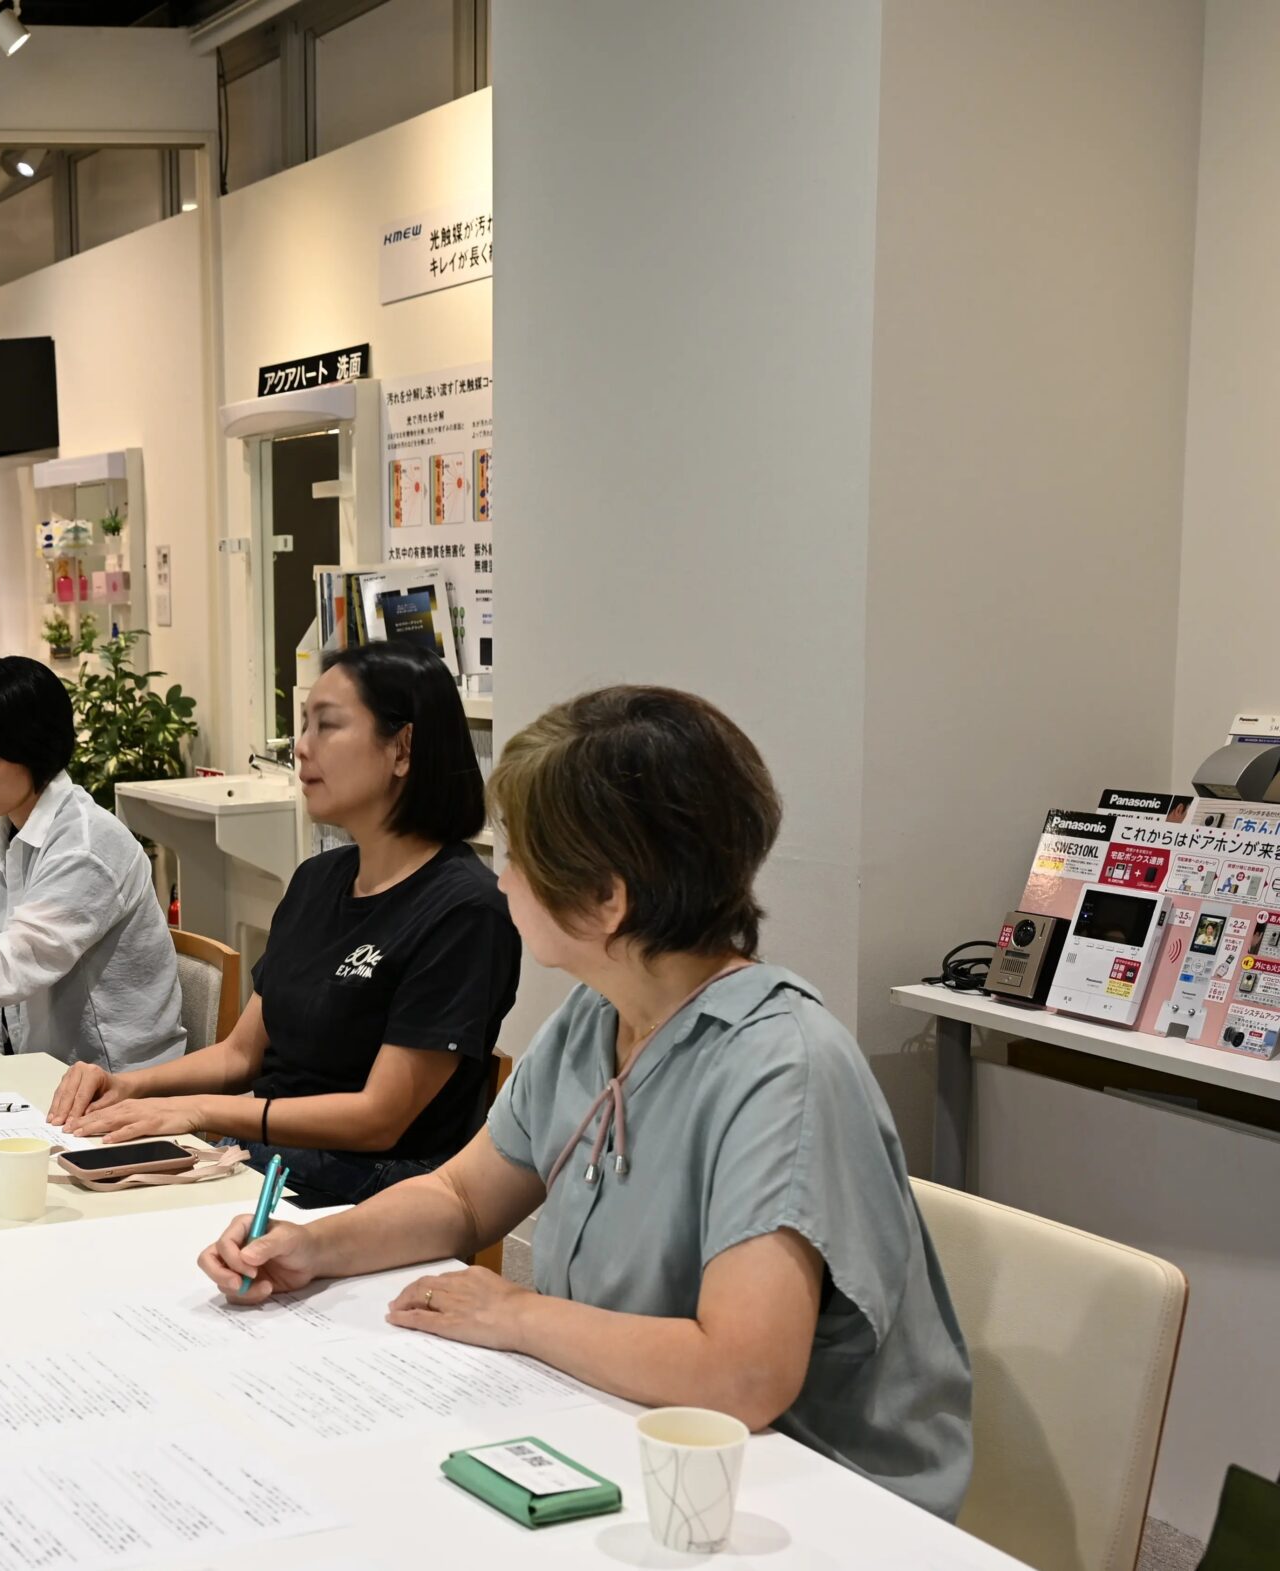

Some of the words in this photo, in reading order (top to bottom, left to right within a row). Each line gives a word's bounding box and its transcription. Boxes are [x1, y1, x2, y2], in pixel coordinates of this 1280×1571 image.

[383, 224, 422, 246] KMEW
[263, 360, 328, 395] アクアハート
[336, 351, 362, 380] 洗面
[1109, 793, 1162, 810] Panasonic
[1051, 815, 1108, 835] Panasonic
[1111, 850, 1165, 867] 宅配ボックス連携
